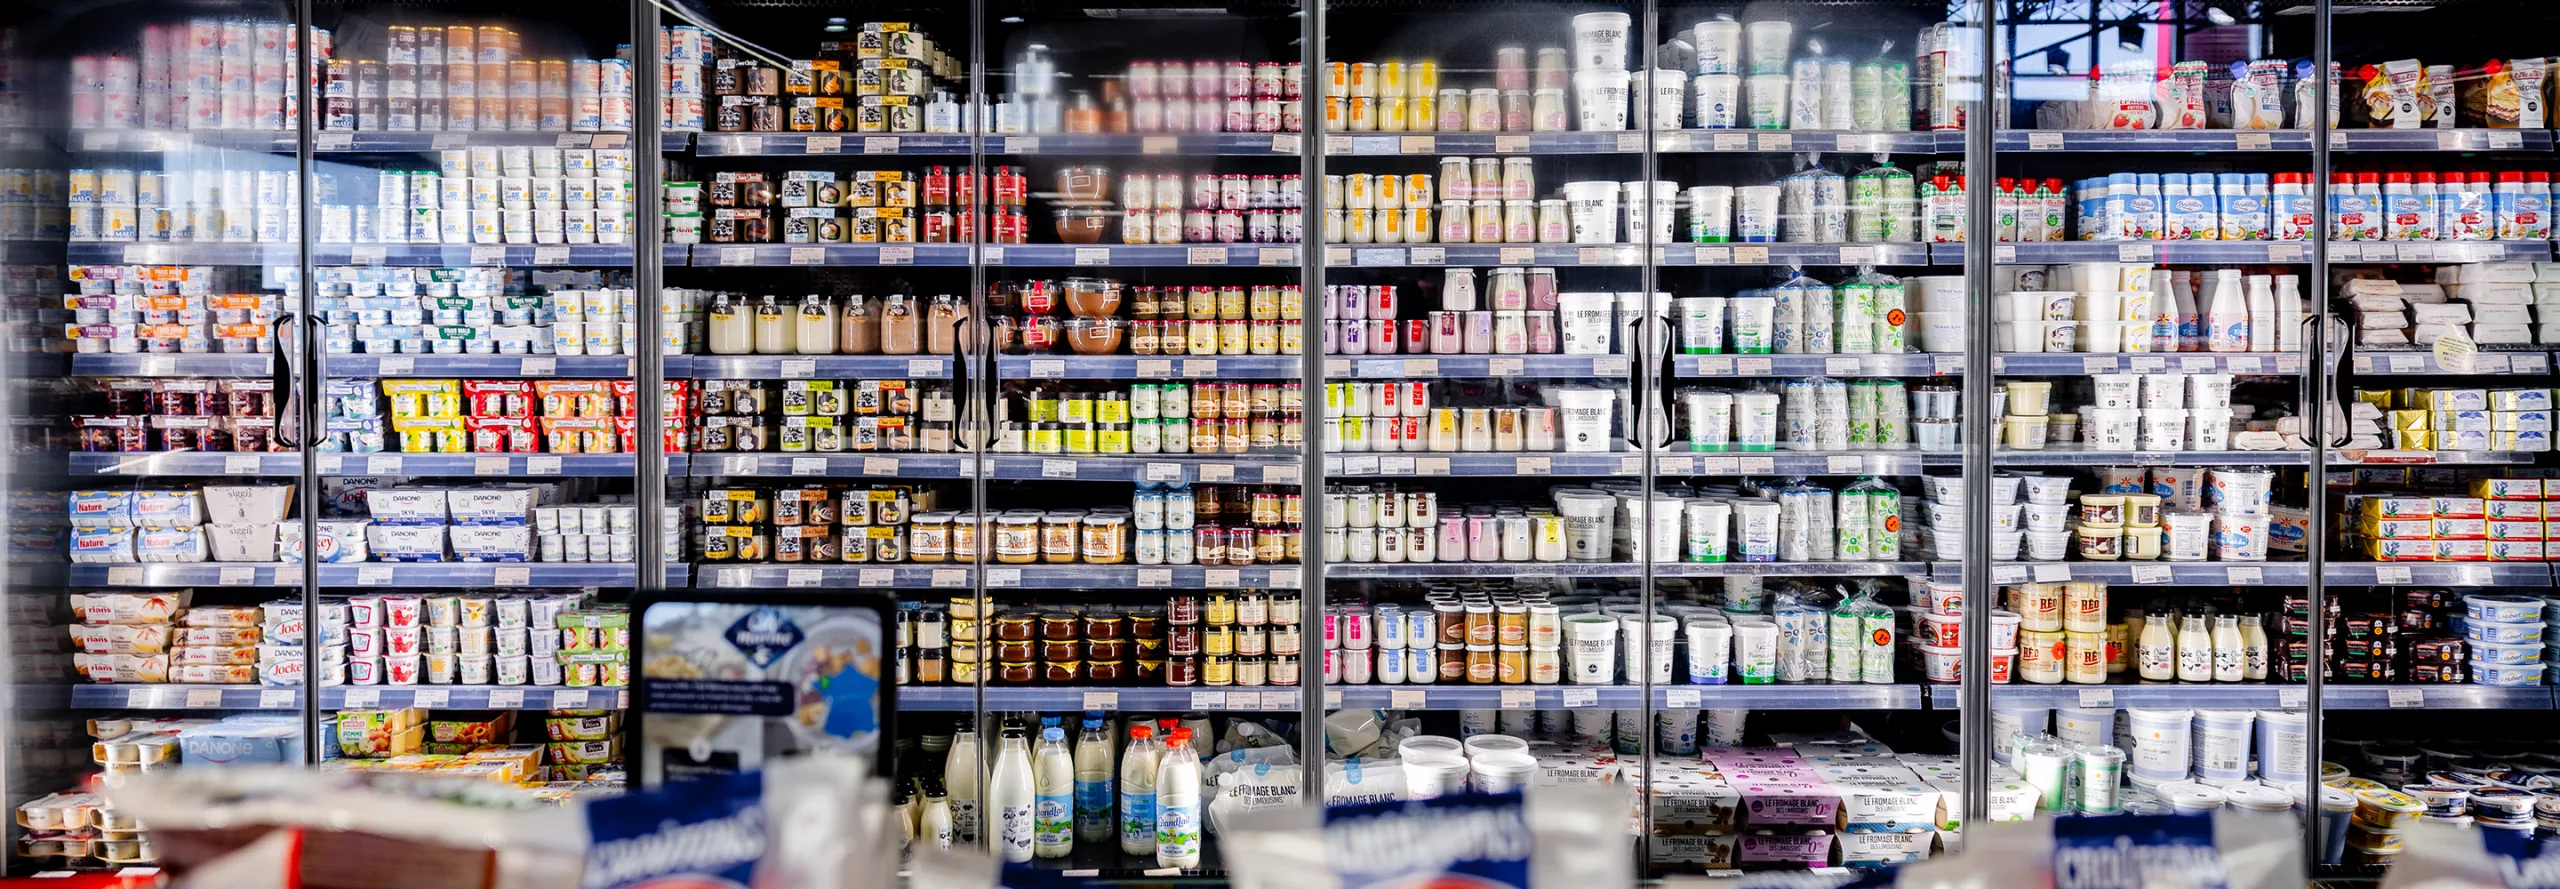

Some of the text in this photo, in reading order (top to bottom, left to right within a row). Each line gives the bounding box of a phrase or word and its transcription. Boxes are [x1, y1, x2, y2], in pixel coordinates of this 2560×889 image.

[343, 477, 378, 486] DANONE
[78, 503, 102, 513] Nature
[140, 503, 164, 513] Nature
[78, 538, 104, 549] Nature
[145, 537, 171, 547] Nature
[2081, 599, 2099, 610] RÉO
[88, 606, 111, 614] rians
[91, 664, 112, 672] rians
[1271, 784, 1297, 796] BLANC
[1332, 794, 1367, 807] FROMAGE
[1663, 799, 1671, 808] LE
[1672, 799, 1698, 808] FROMAGE
[1765, 799, 1819, 808] LE FROMAGE BLANC
[1864, 797, 1871, 805] LE
[1873, 796, 1898, 805] FROMAGE
[1662, 838, 1716, 846] LE FROMAGE BLANC
[1759, 836, 1812, 845] LE FROMAGE BLANC
[1867, 834, 1892, 843] FROMAGE
[1894, 834, 1913, 843] BLANC
